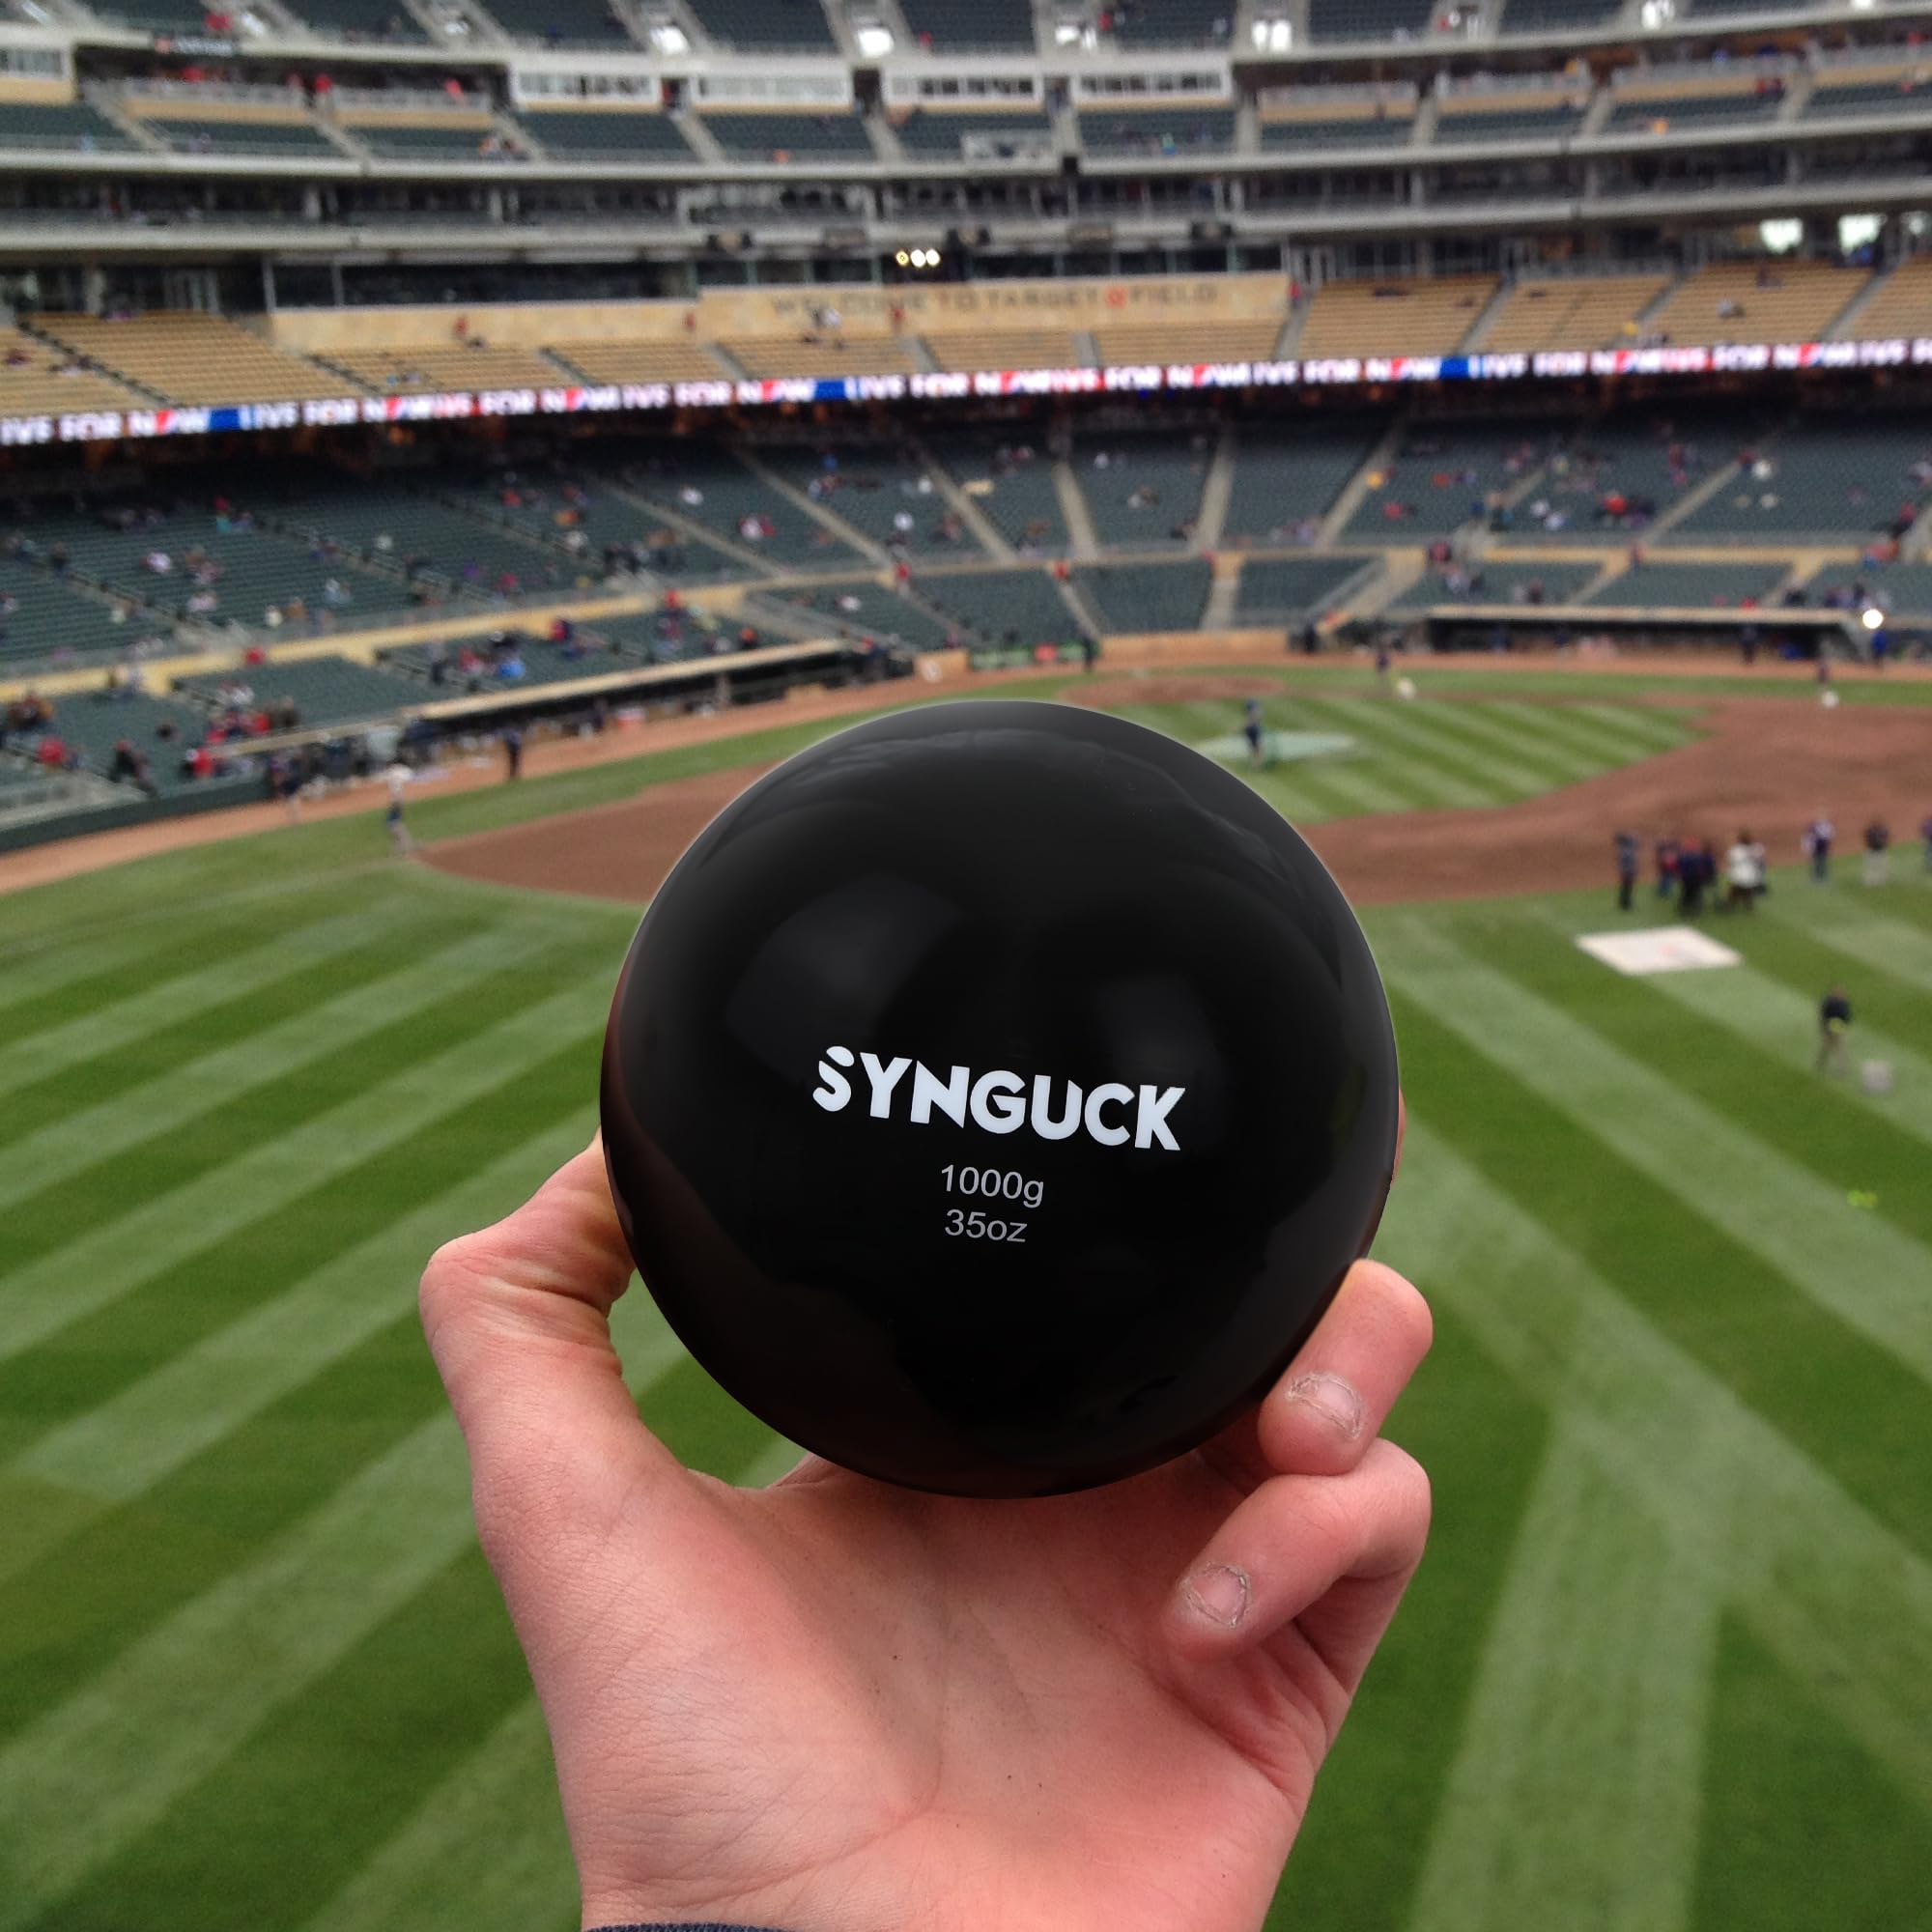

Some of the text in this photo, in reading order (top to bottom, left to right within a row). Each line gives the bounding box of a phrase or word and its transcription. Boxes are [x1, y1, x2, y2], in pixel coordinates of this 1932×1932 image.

[812, 1045, 1186, 1151] SYNGUCK
[941, 1164, 1044, 1208] 1000g
[944, 1208, 1028, 1242] 35oz
